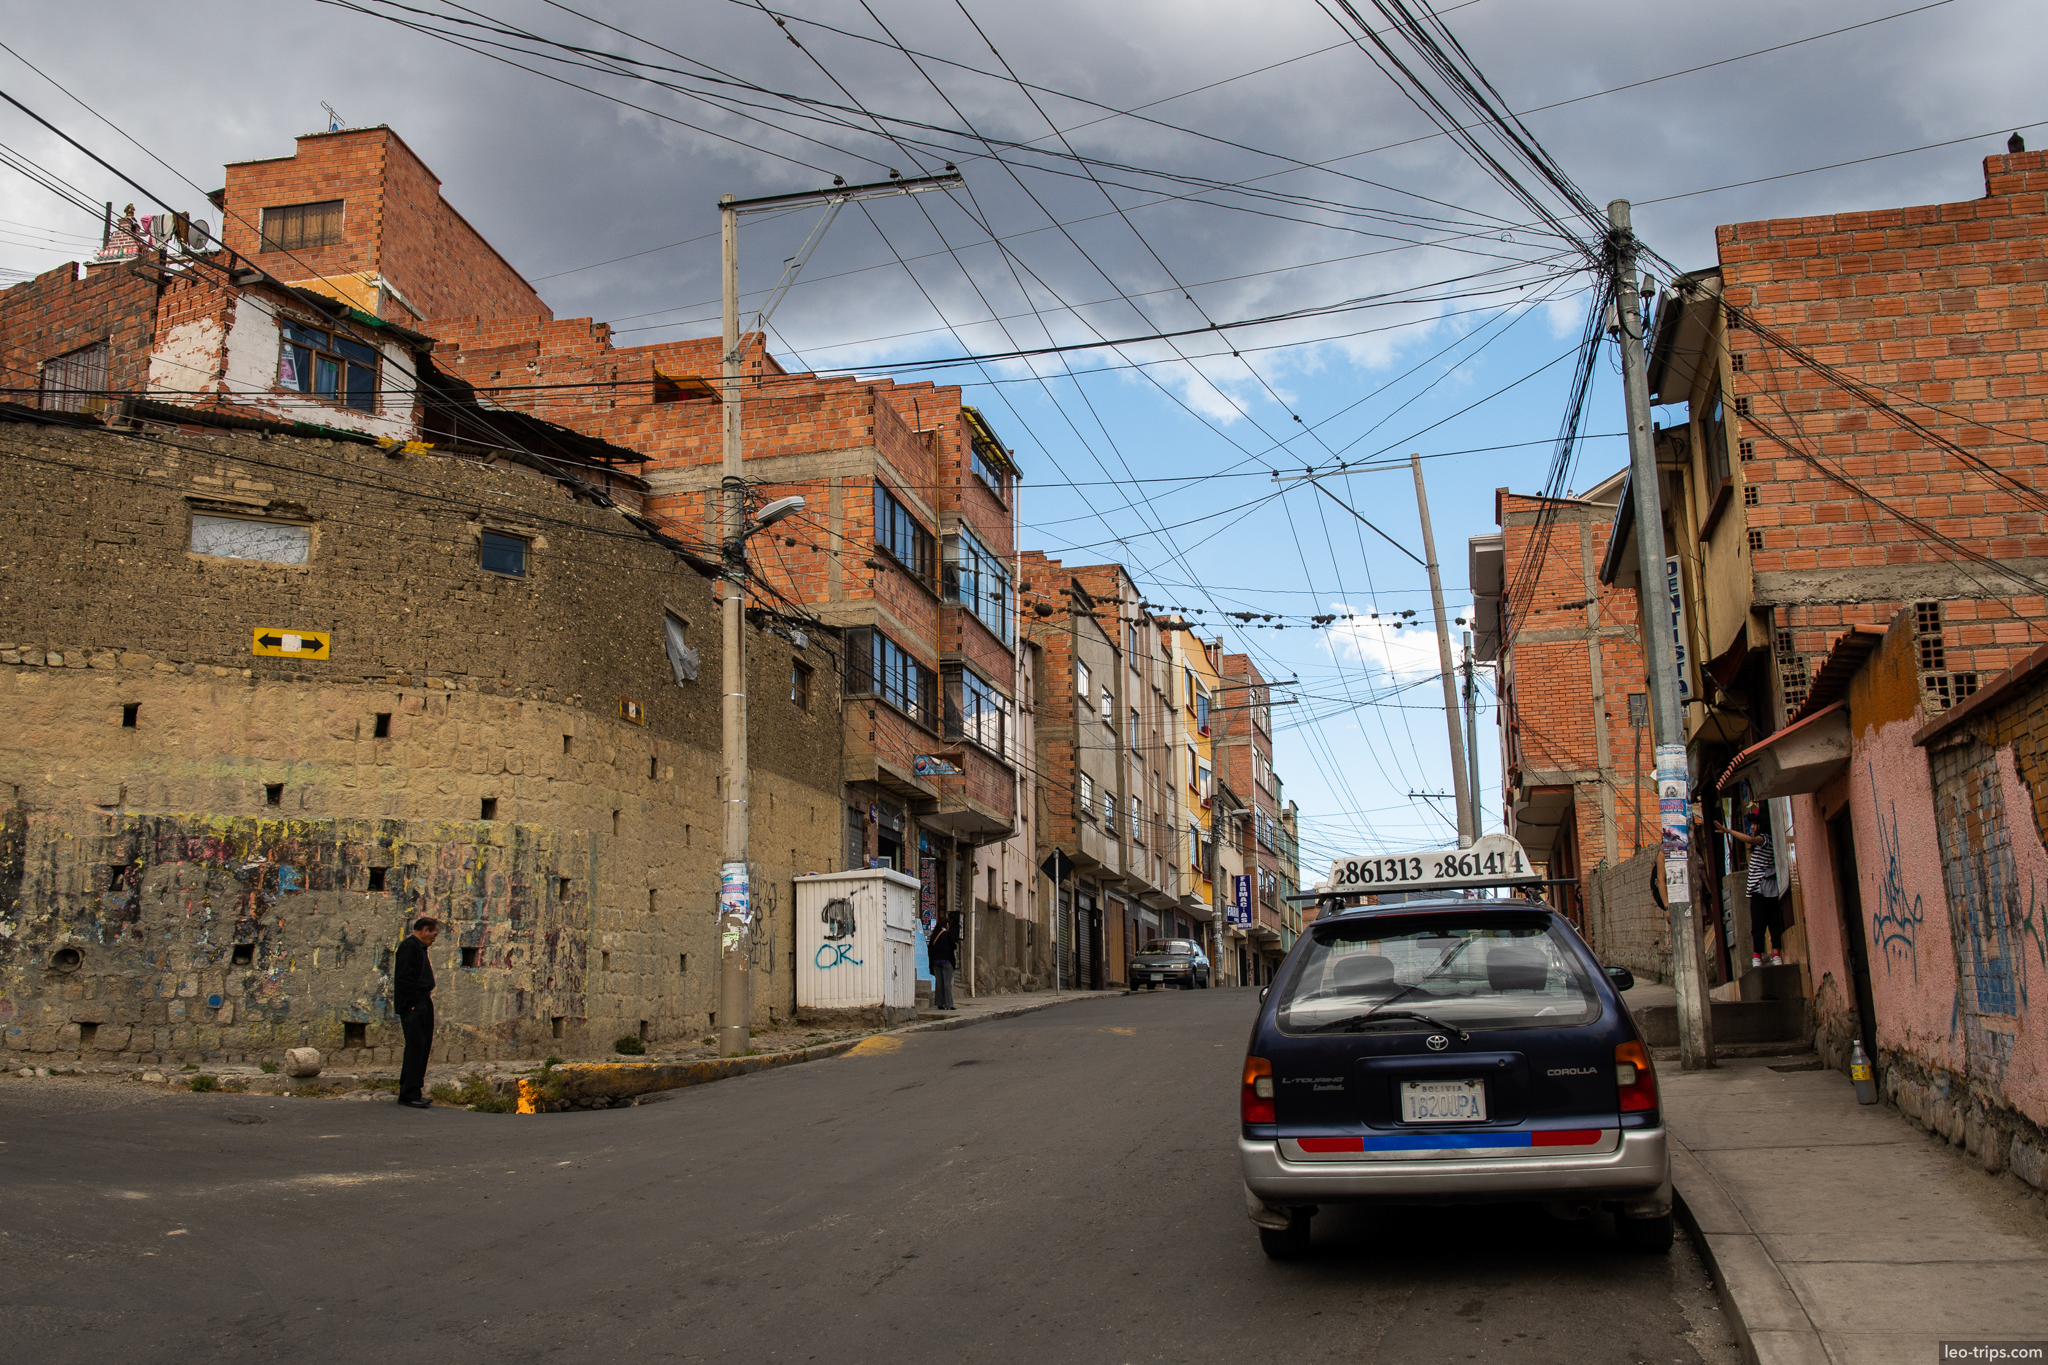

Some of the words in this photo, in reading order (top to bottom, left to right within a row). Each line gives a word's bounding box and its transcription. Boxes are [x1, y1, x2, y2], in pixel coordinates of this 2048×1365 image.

[1334, 856, 1423, 885] 2861313
[1434, 850, 1523, 879] 2861414
[1546, 1066, 1598, 1077] COROLLA
[1422, 1085, 1463, 1093] BOLIVIA
[1409, 1094, 1480, 1118] 1820UPA
